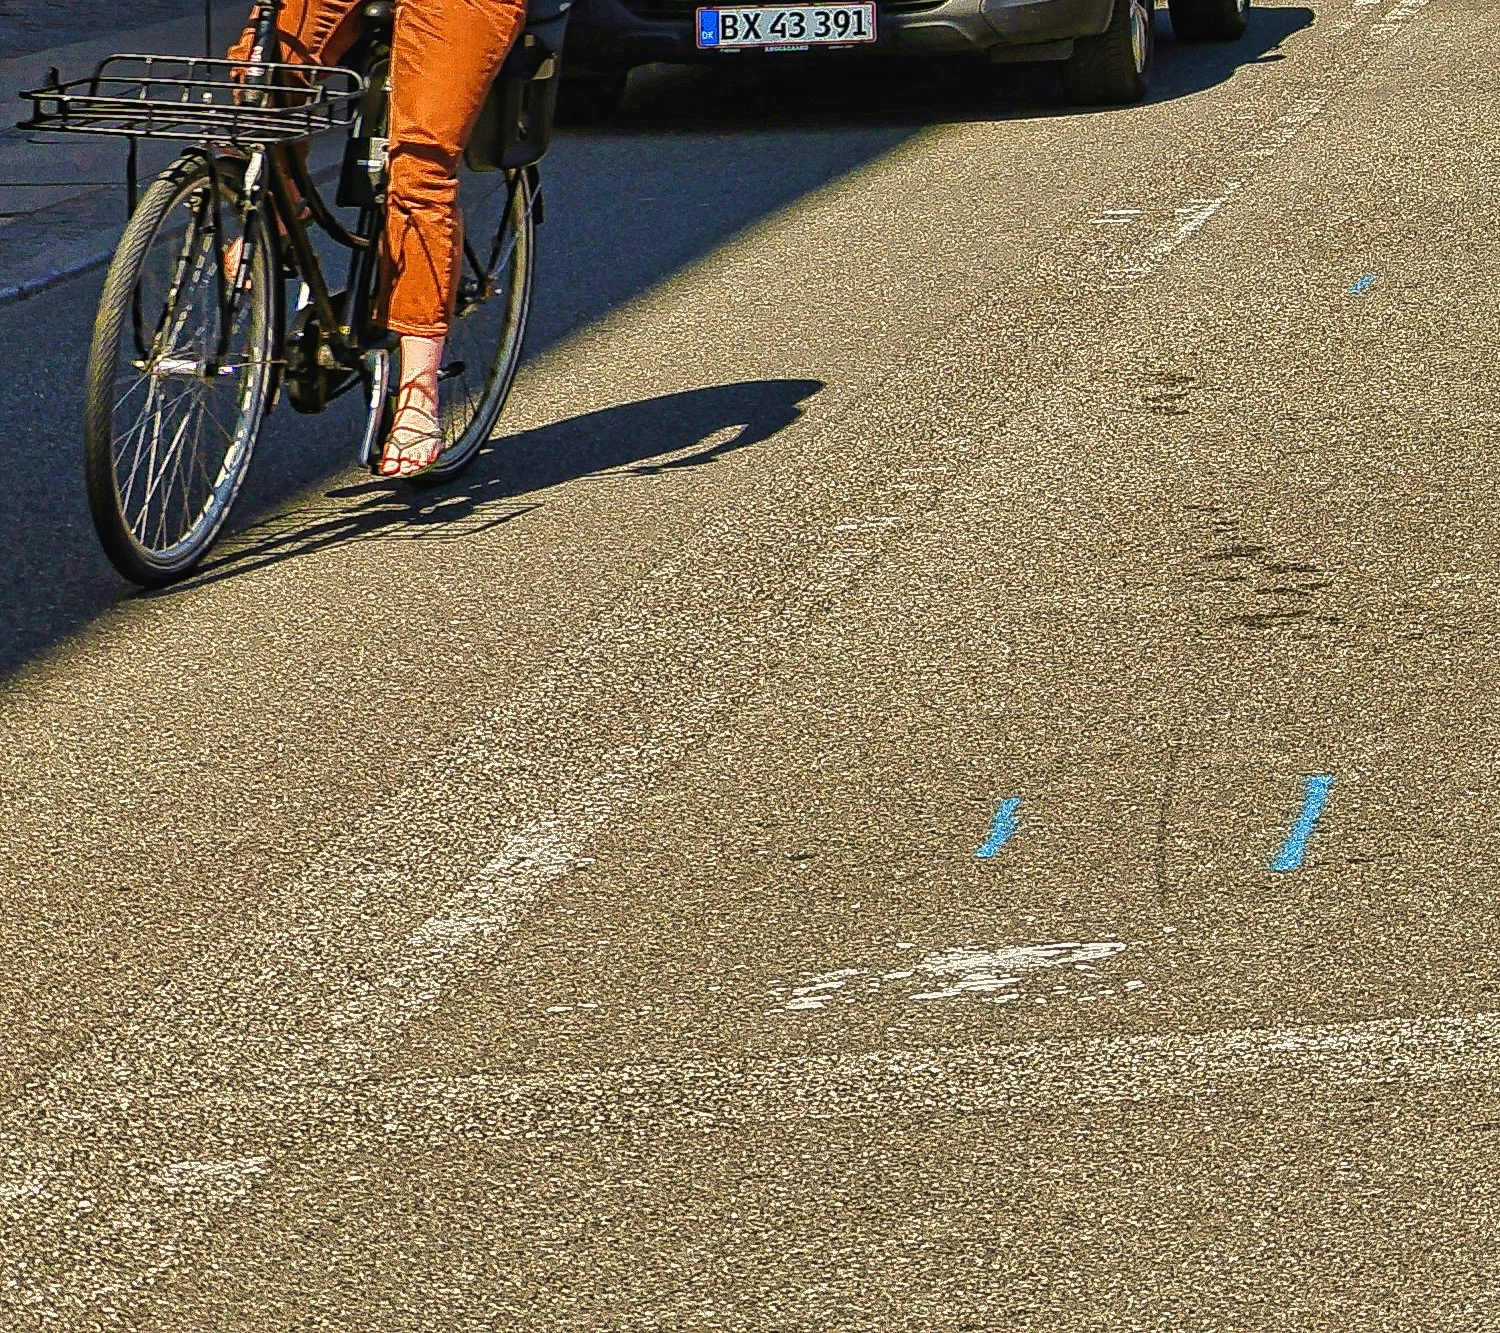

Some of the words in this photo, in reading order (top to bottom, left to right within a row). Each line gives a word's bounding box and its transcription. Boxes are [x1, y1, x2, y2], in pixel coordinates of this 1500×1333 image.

[702, 30, 714, 40] DK
[721, 12, 762, 41] BX
[769, 11, 807, 39] 43
[813, 8, 867, 38] 391
